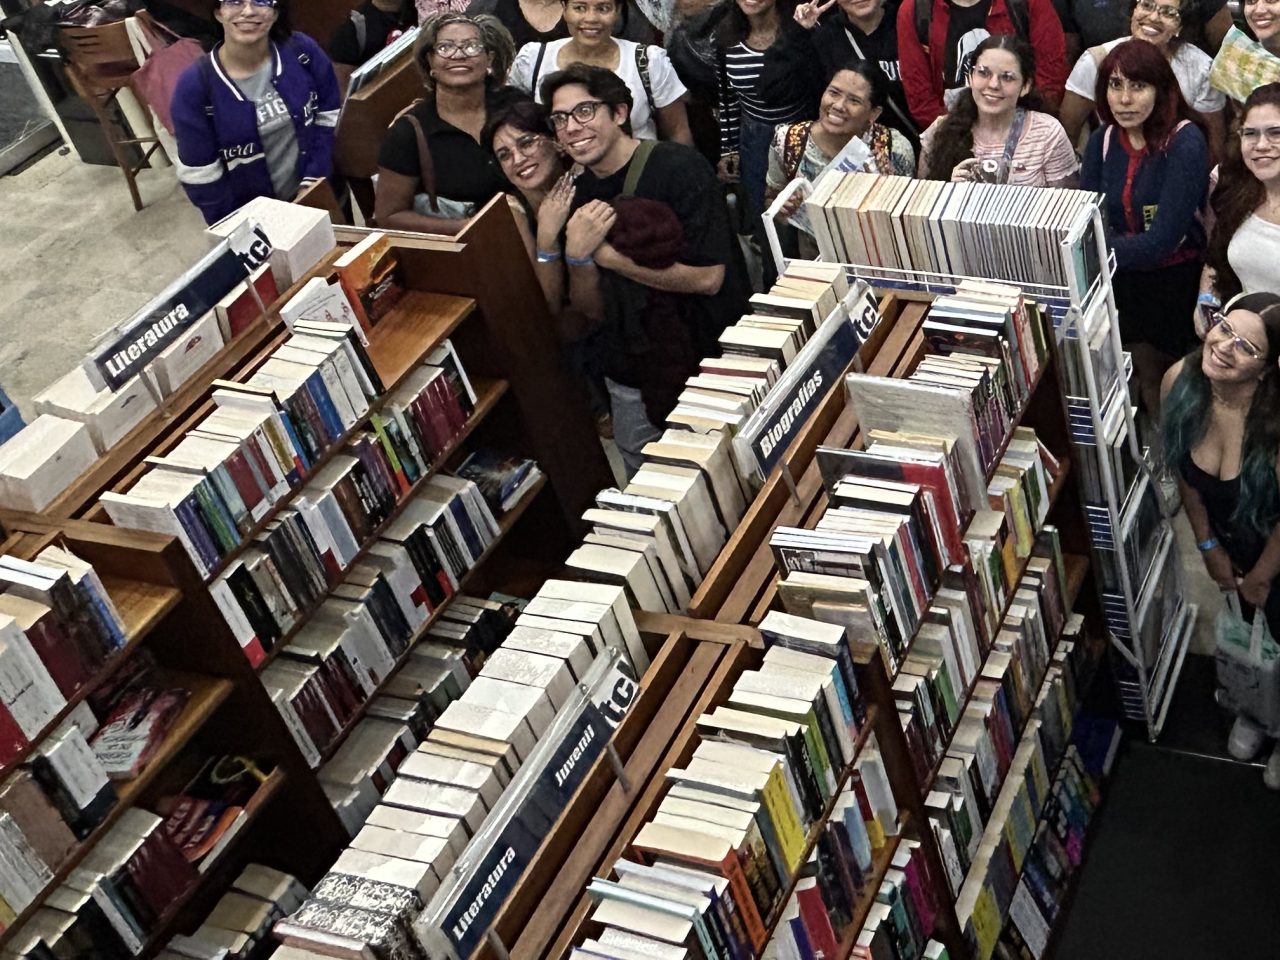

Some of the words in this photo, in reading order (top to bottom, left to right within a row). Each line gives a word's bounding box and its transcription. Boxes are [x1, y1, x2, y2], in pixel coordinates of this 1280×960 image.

[104, 302, 189, 378] Literatura
[856, 292, 879, 340] tcl
[602, 659, 635, 723] tcl
